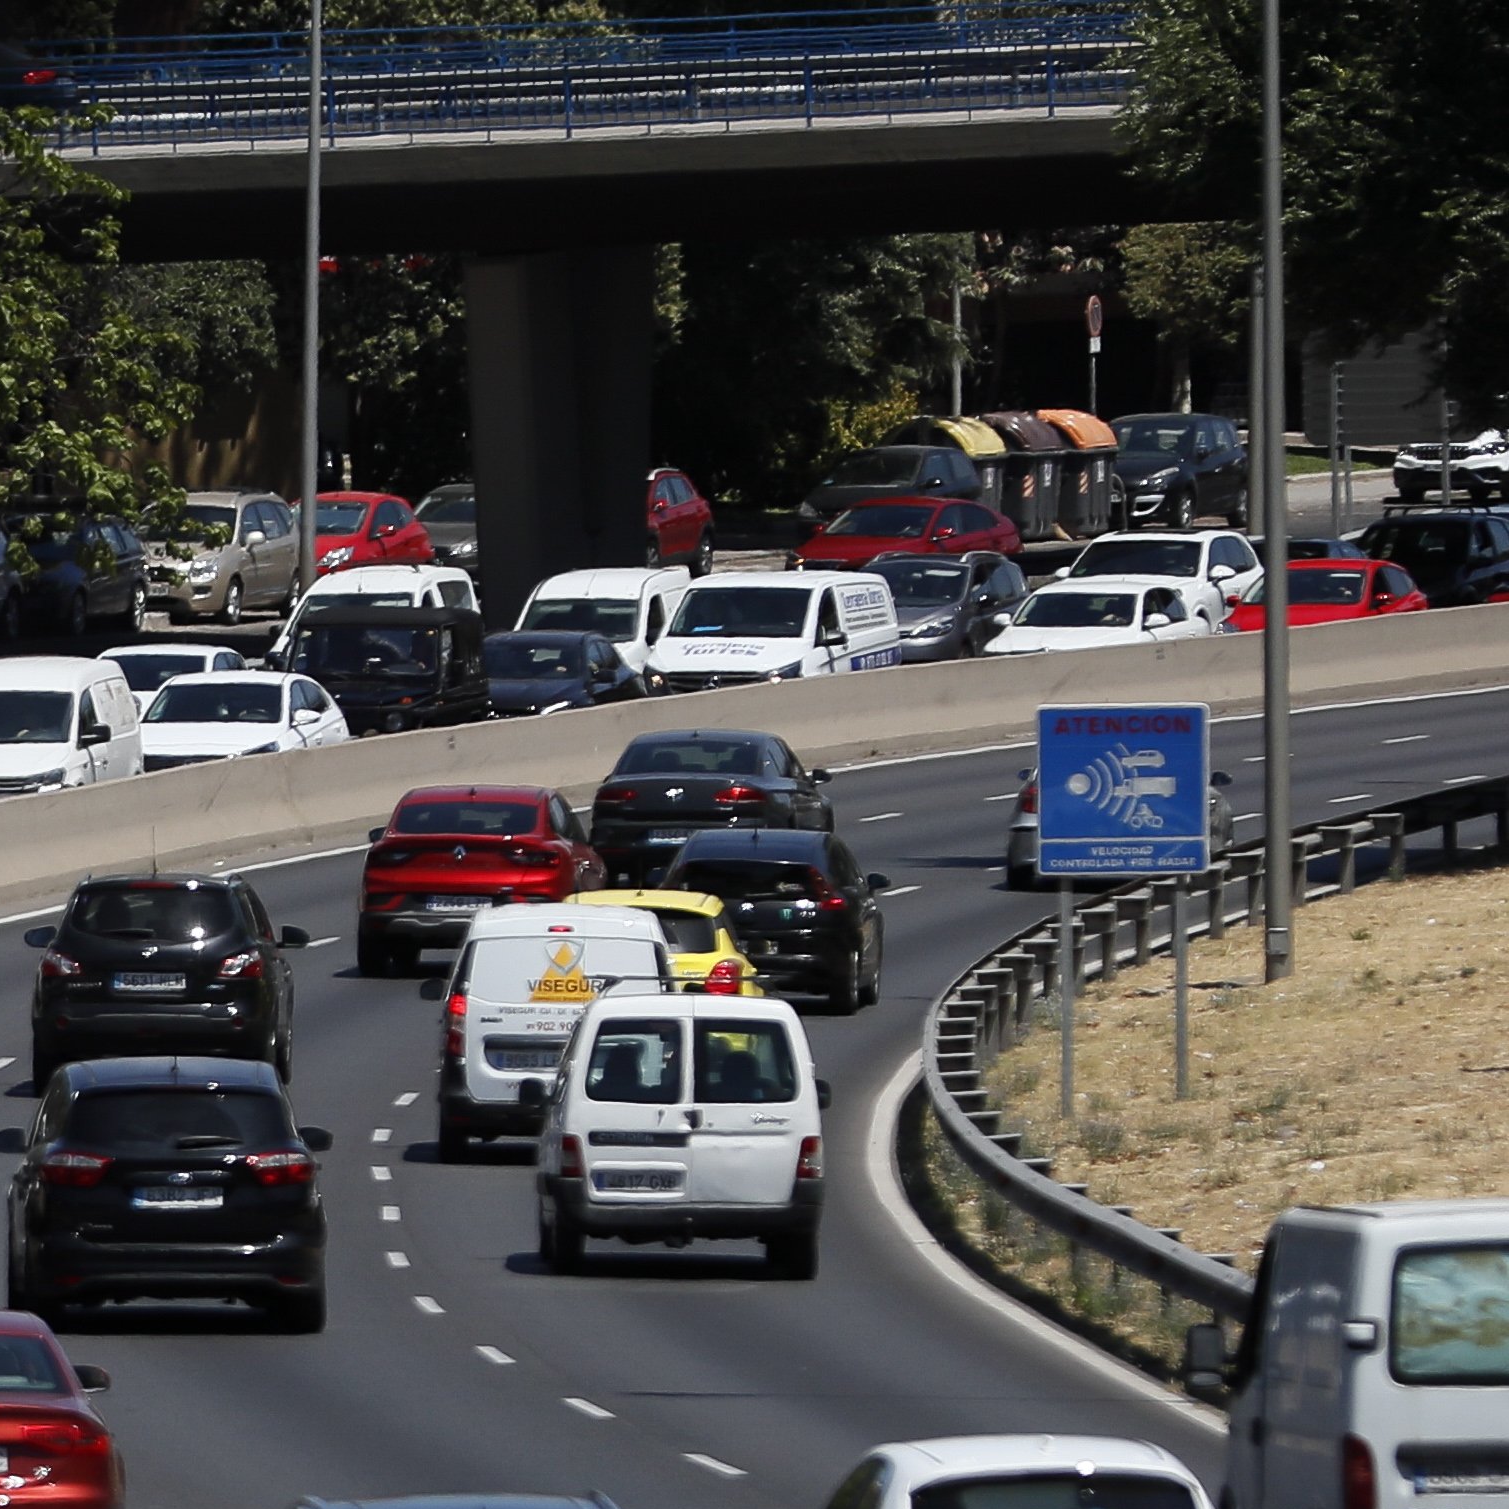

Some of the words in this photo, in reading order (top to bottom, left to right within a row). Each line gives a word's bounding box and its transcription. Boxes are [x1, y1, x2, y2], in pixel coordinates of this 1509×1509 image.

[1091, 846, 1153, 857] VELOCIDAD
[1050, 859, 1124, 870] CONTROLADA
[1130, 859, 1152, 868] POR
[527, 979, 603, 993] VISEGUR
[537, 1021, 556, 1031] 902
